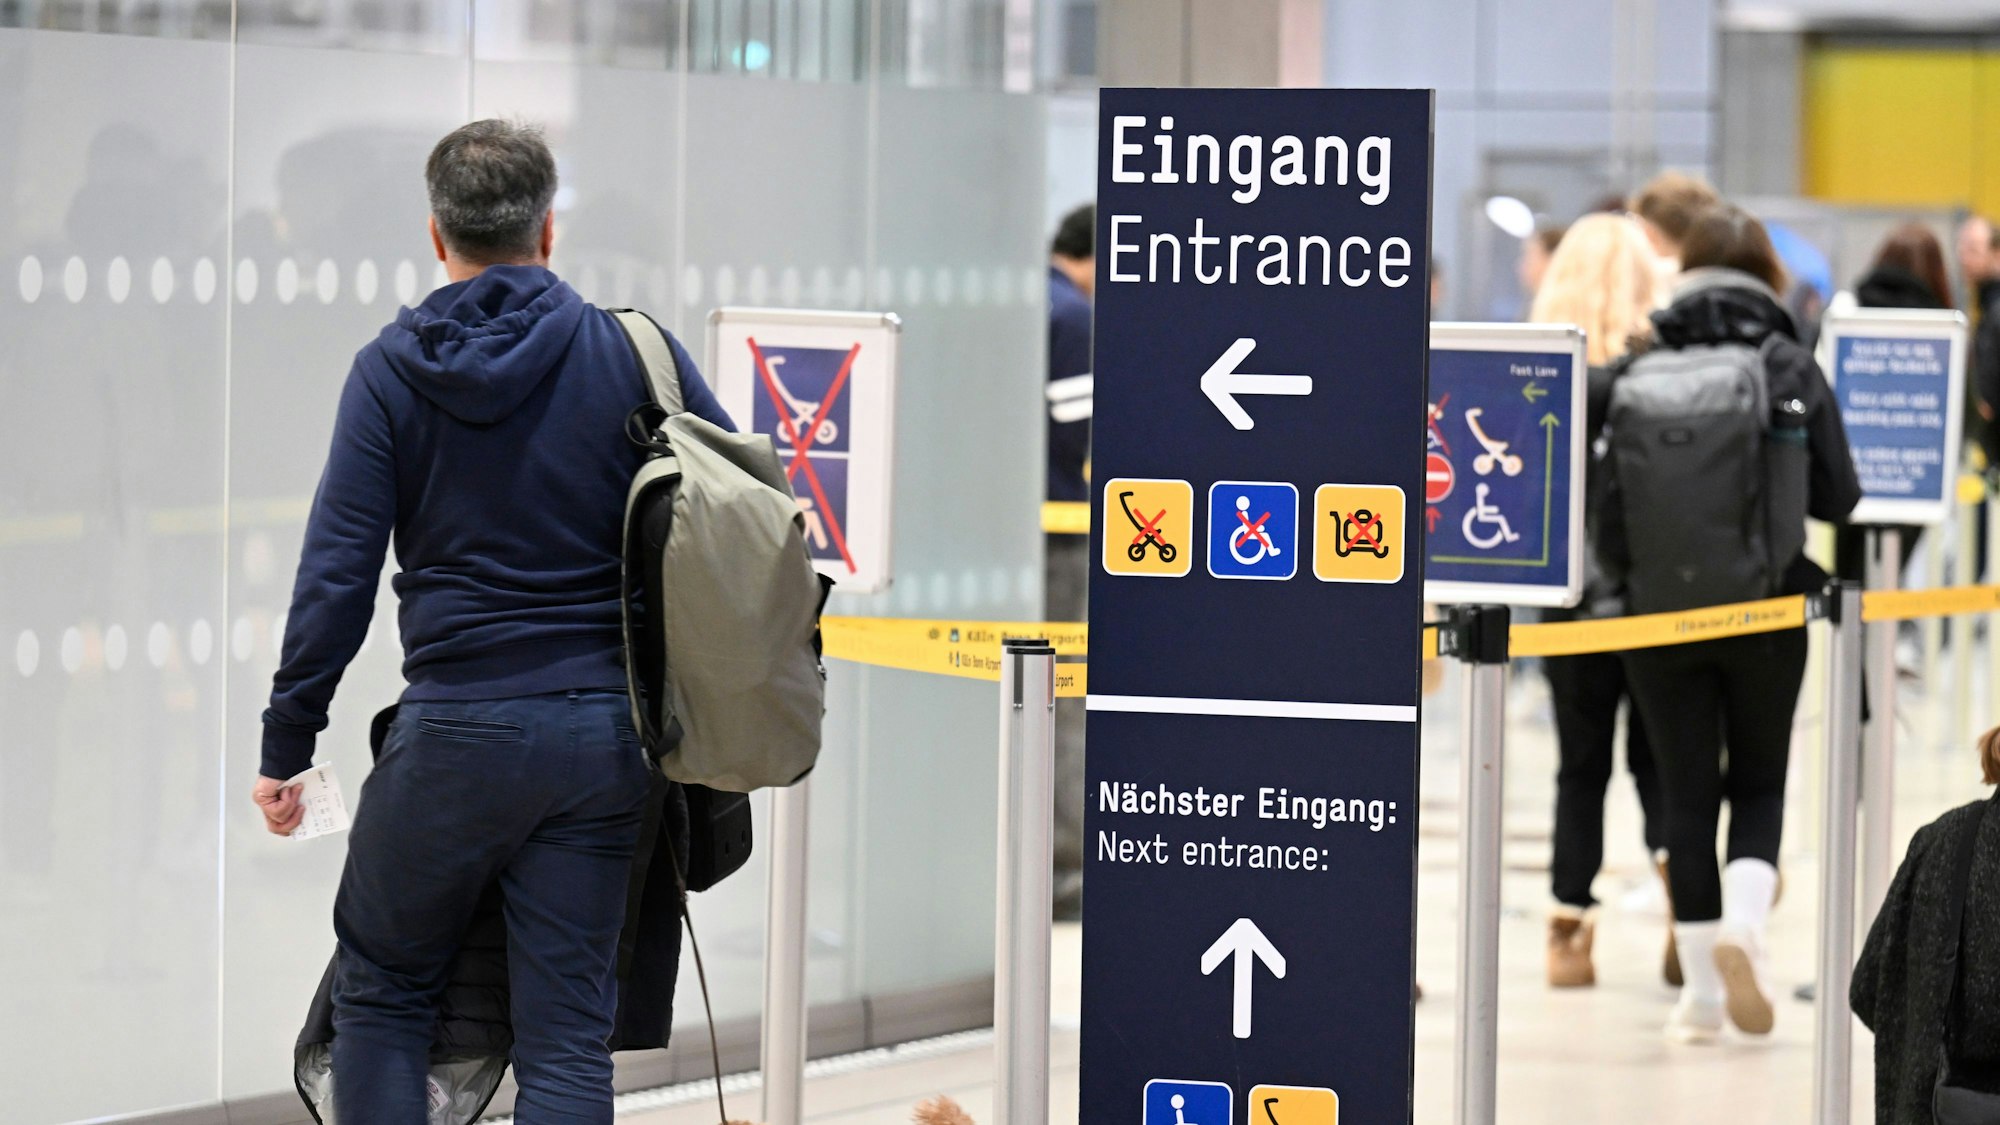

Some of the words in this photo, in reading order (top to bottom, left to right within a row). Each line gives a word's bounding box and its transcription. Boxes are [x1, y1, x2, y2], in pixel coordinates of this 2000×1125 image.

[1112, 115, 1392, 206] Eingang
[1109, 214, 1412, 289] Entrance
[1510, 364, 1533, 377] Fast
[1535, 365, 1558, 378] Lane
[1055, 673, 1073, 691] irport
[1099, 780, 1245, 819] Nächster
[1258, 787, 1398, 832] Eingang:
[1098, 830, 1169, 866] Next
[1182, 836, 1329, 872] entrance:
